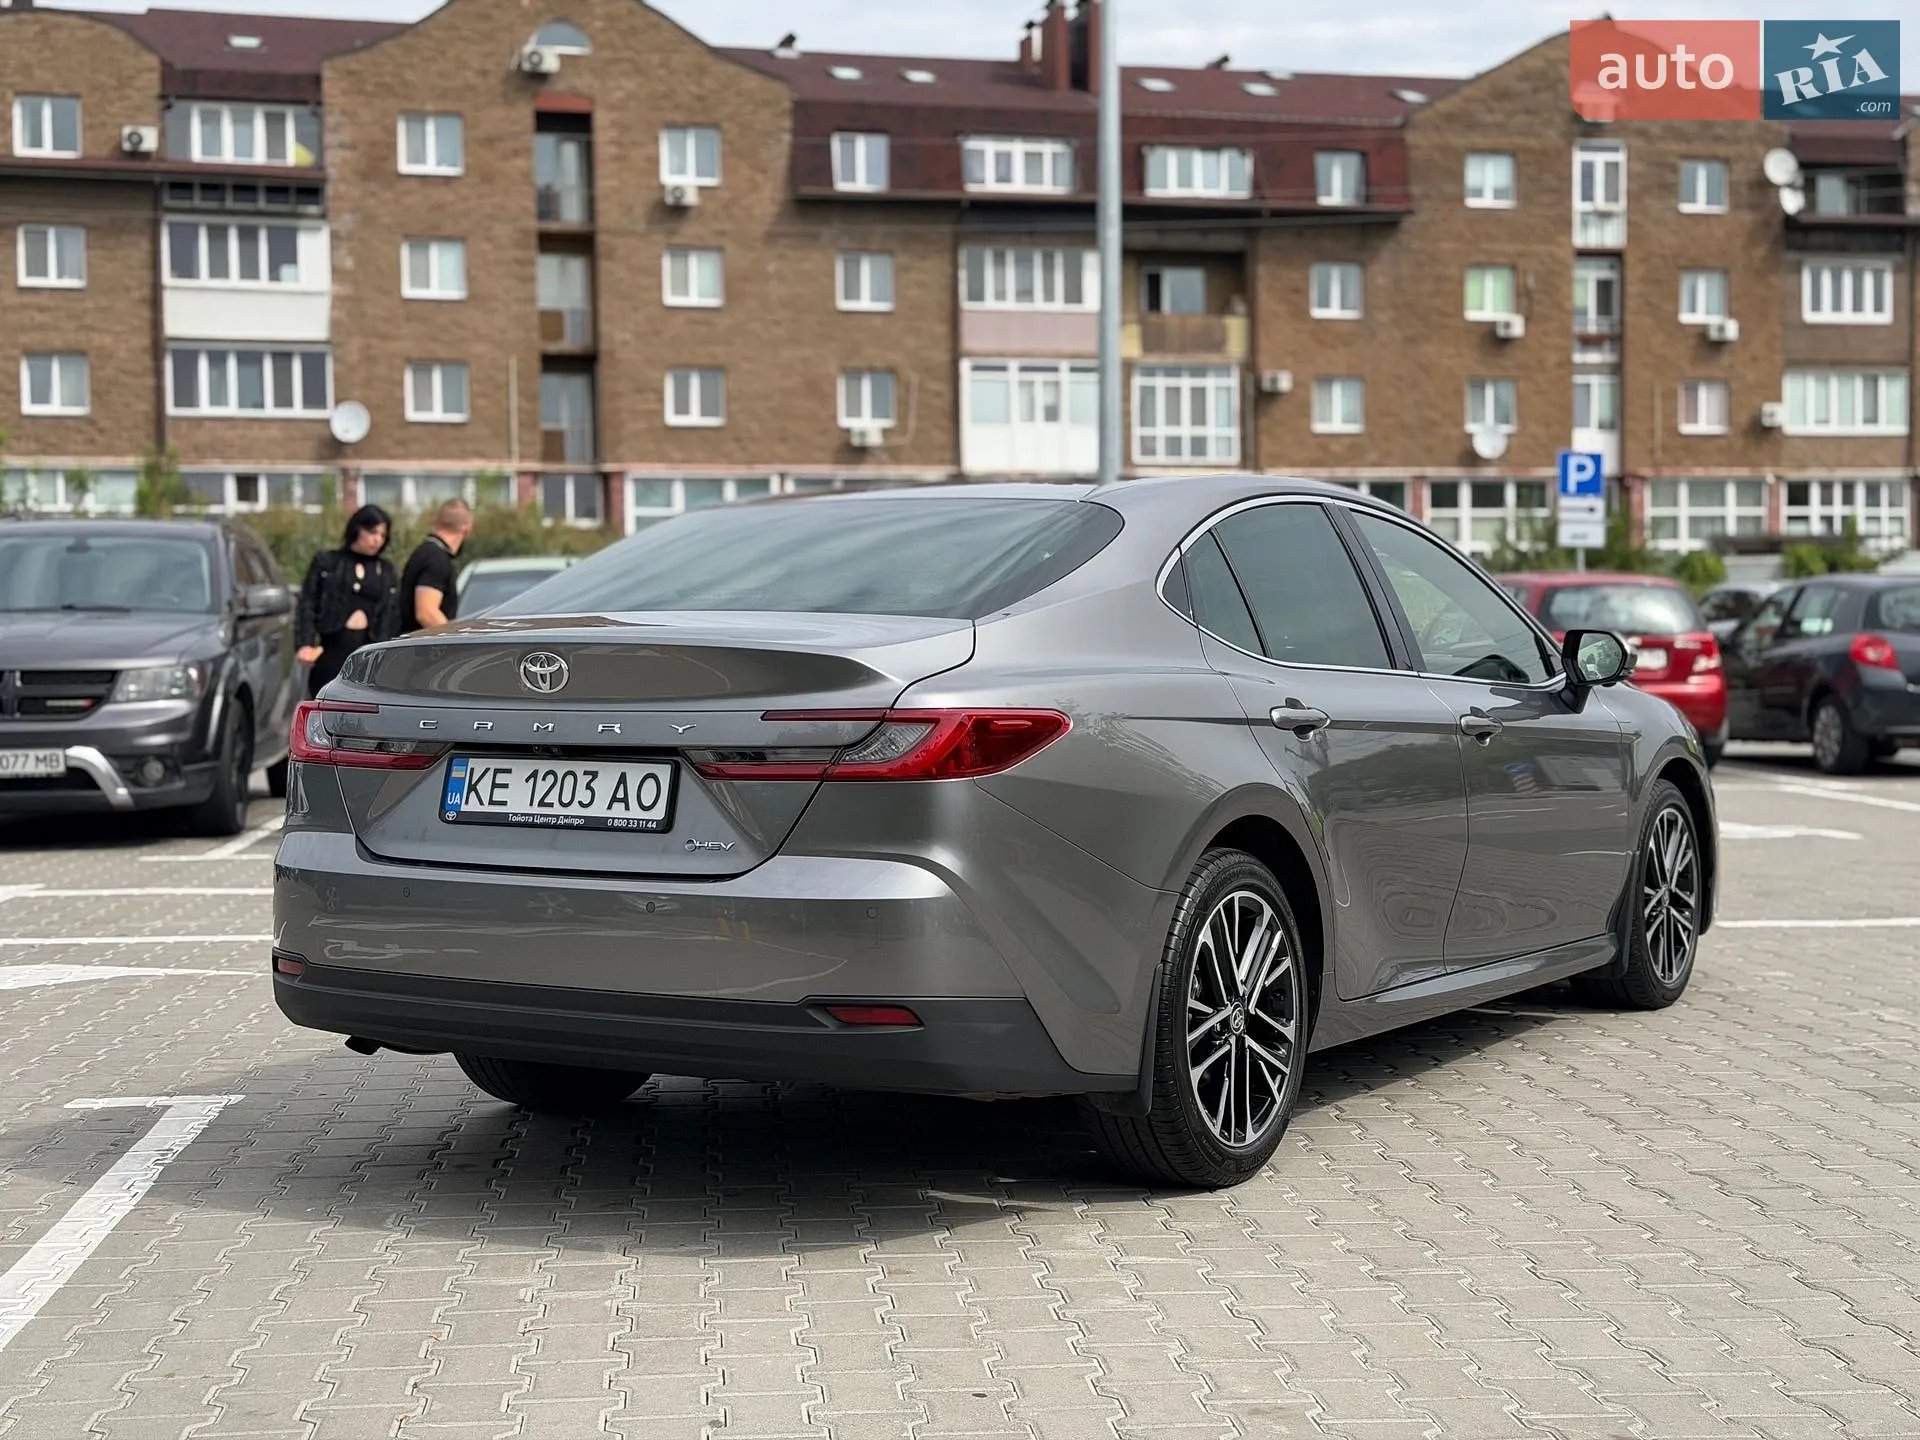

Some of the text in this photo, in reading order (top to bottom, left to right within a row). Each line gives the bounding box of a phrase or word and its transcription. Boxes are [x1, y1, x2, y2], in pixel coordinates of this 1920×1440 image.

[1566, 454, 1596, 494] P
[419, 720, 697, 734] CAMRY
[464, 767, 662, 812] KE 1203 AO
[447, 792, 461, 805] UA
[508, 813, 585, 827] Тойота Центр Дніпро
[607, 819, 657, 829] 0 800 33 11 44
[696, 840, 736, 851] HEV
